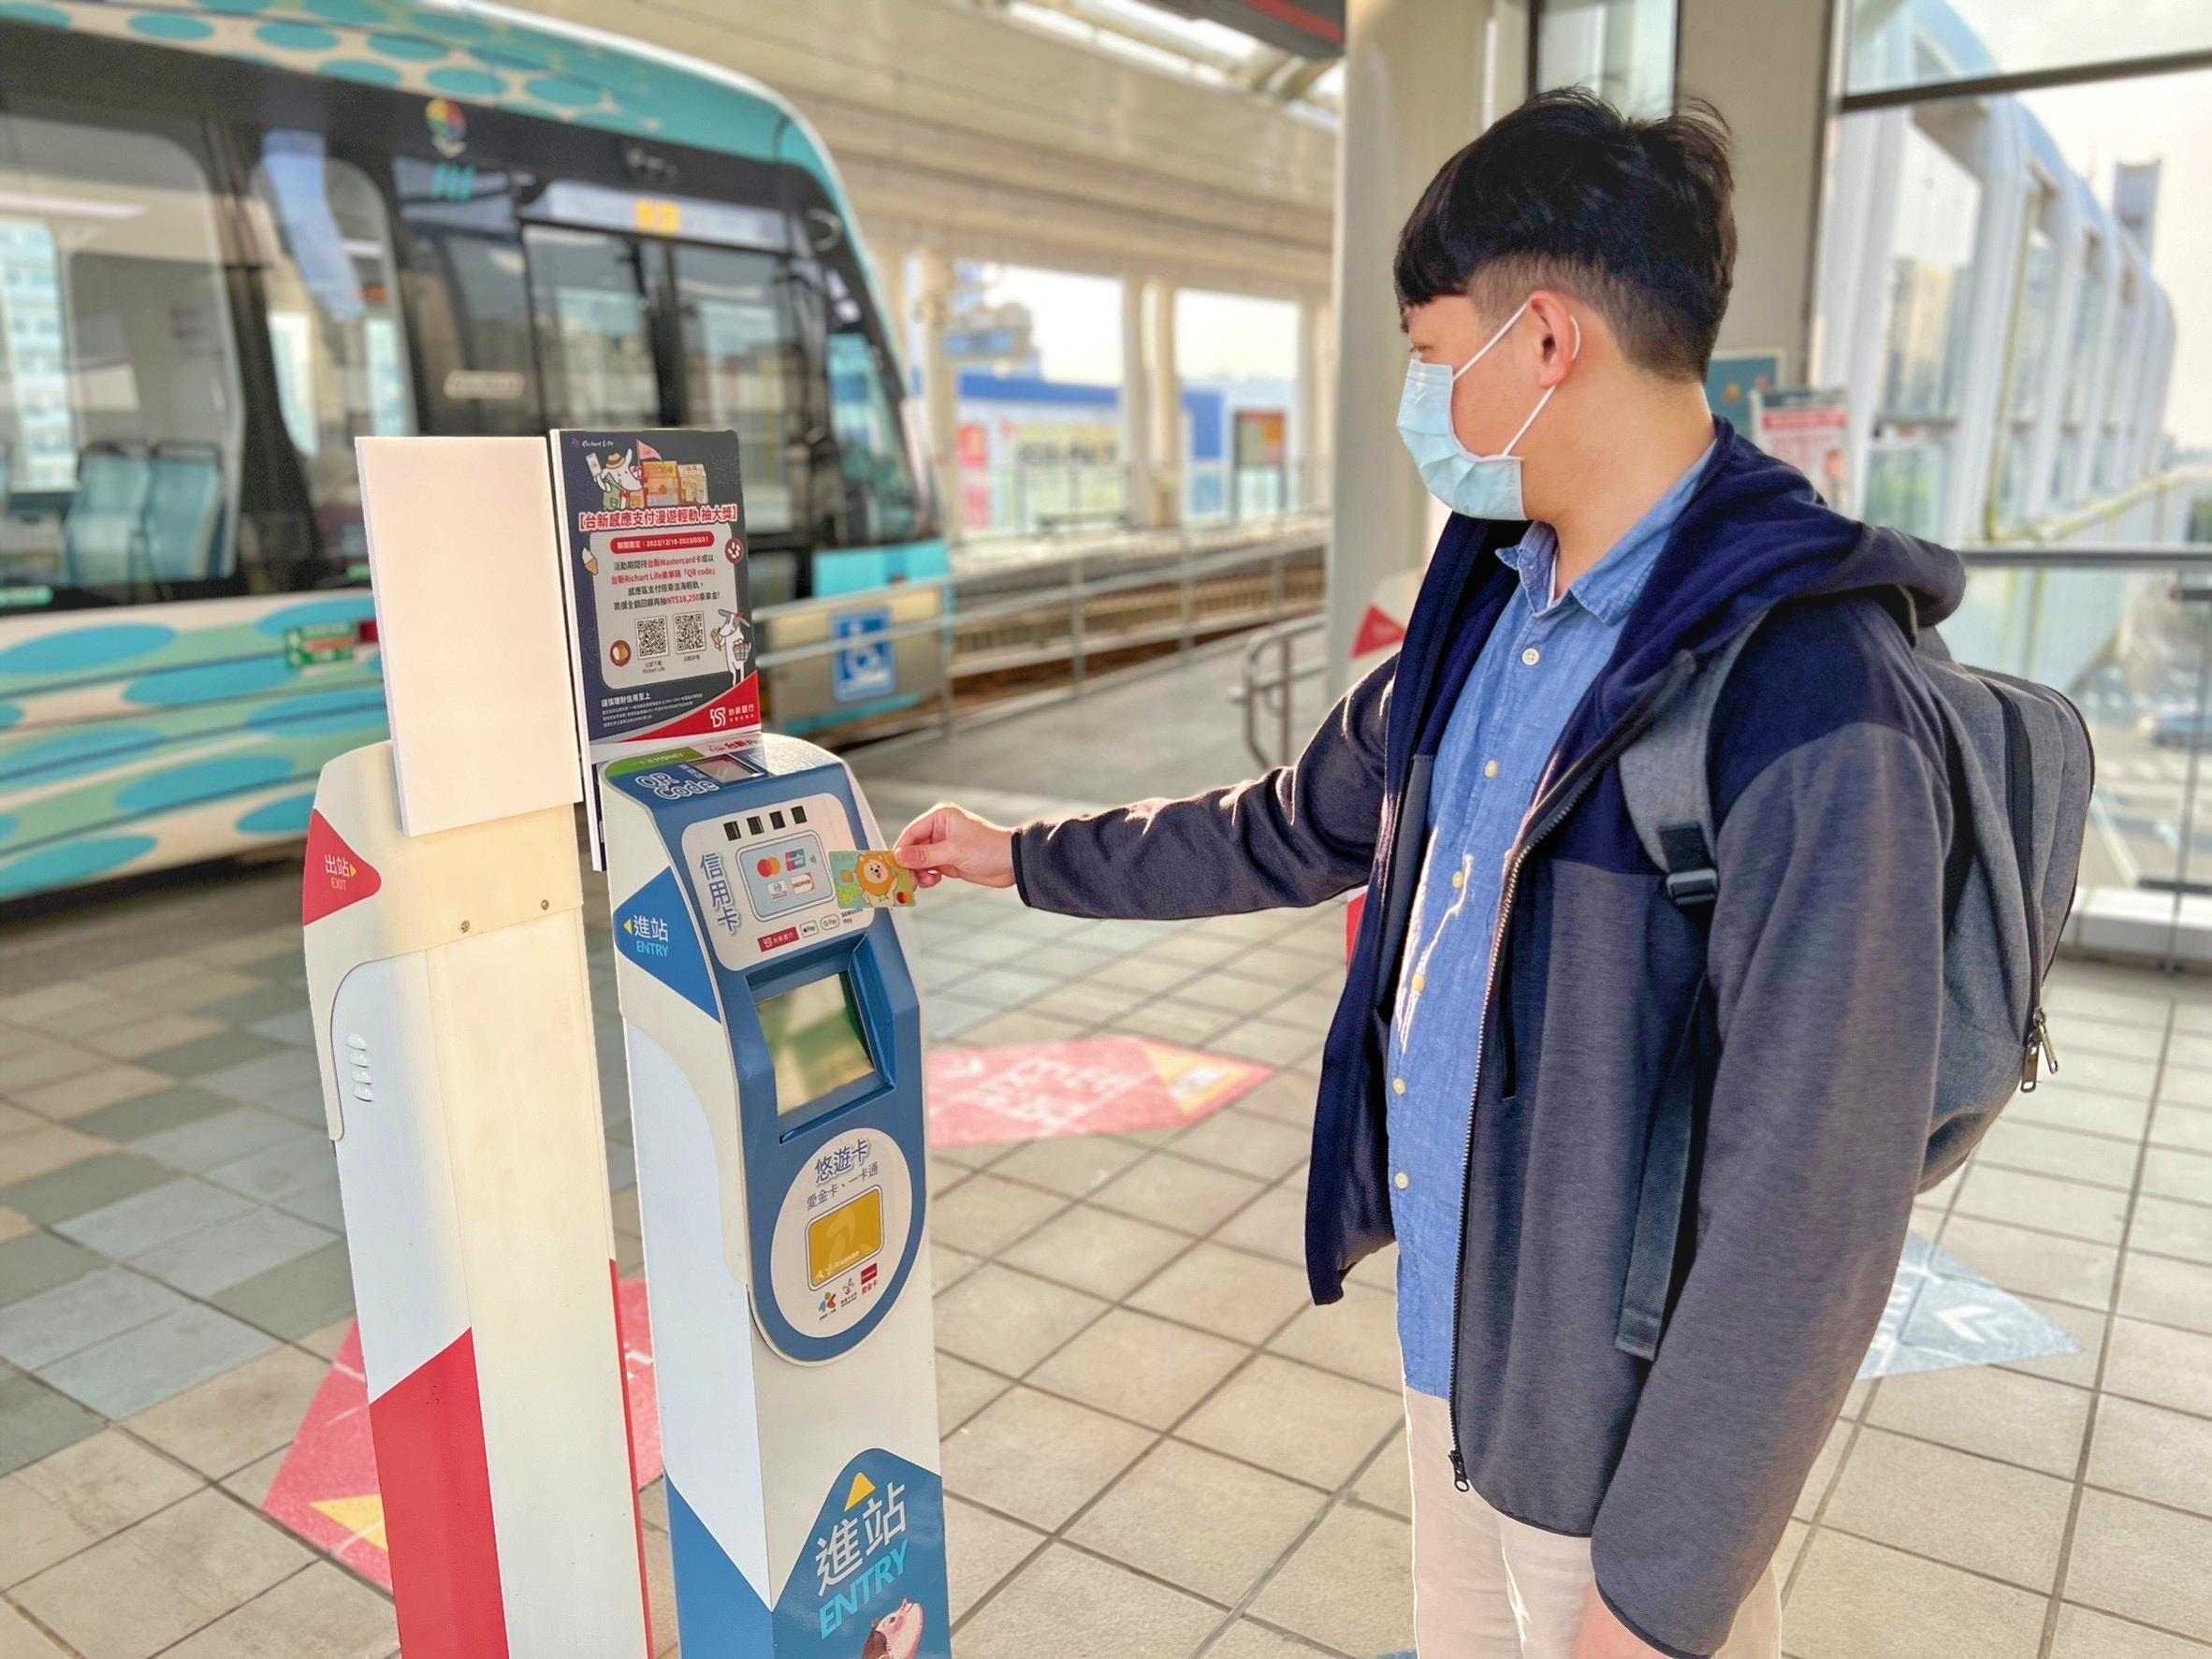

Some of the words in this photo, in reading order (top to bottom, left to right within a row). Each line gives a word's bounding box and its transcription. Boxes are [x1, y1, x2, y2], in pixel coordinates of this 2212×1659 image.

[635, 772, 680, 790] QR
[654, 780, 720, 800] Code
[325, 853, 351, 878] 出站
[331, 877, 347, 891] EXIT
[701, 853, 742, 935] 信用卡
[633, 914, 669, 942] 進站
[636, 940, 669, 957] ENTRY
[815, 1139, 869, 1184] 悠遊卡
[815, 1481, 907, 1596] 進站
[820, 1538, 909, 1639] ENTRY
